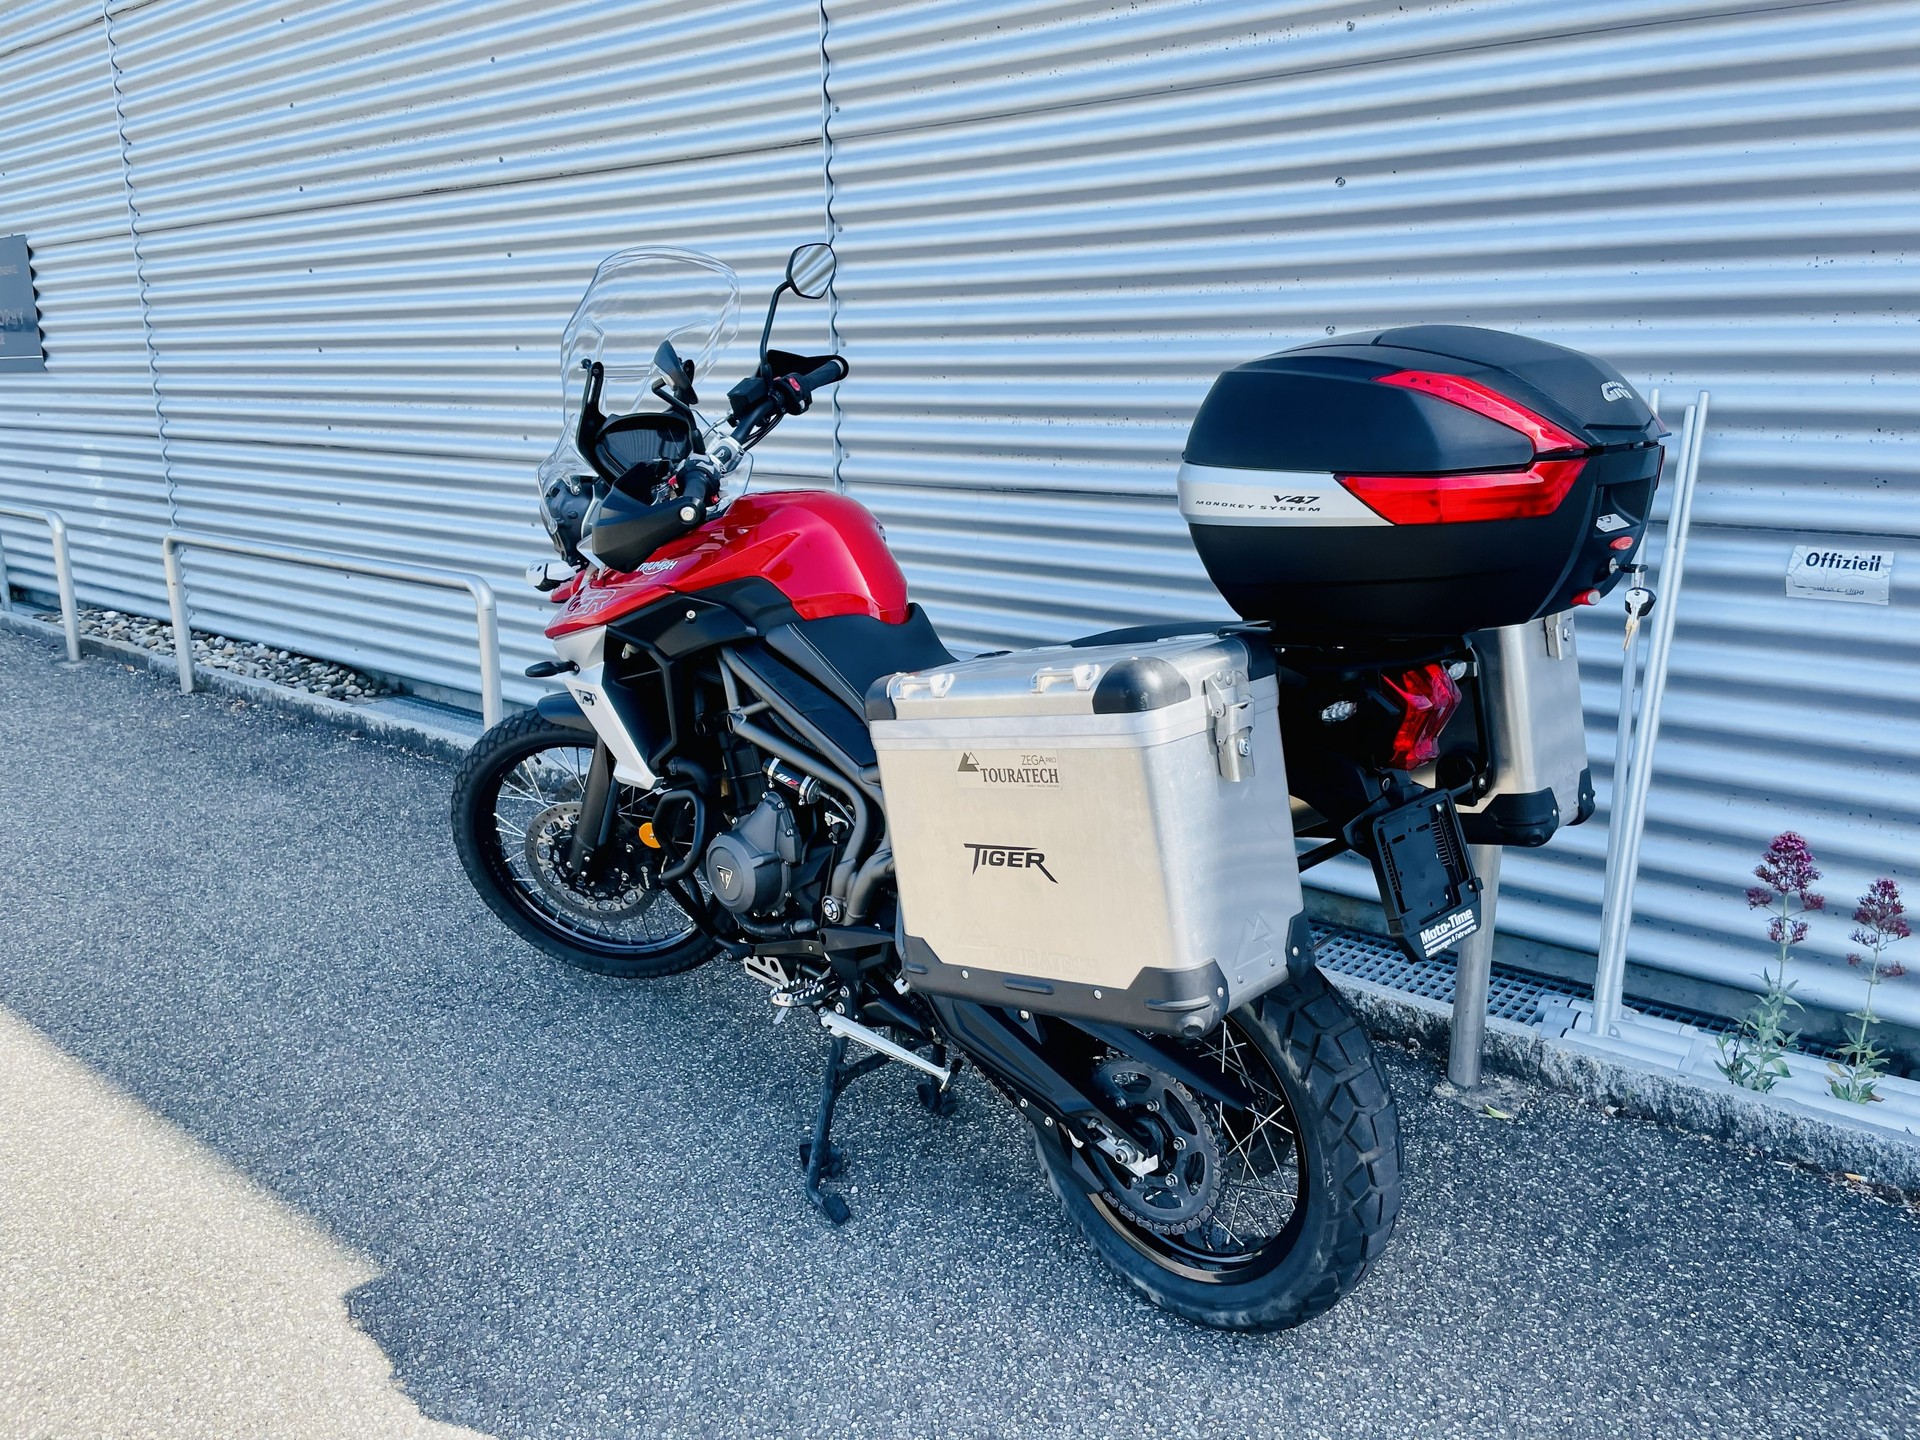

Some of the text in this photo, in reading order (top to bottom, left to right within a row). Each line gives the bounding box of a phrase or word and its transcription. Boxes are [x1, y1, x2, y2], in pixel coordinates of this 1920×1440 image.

[1195, 500, 1255, 509] MONOKEY
[1273, 495, 1320, 504] V47
[1020, 754, 1057, 766] ZEGA PRO
[980, 767, 1060, 784] TOURATECH
[963, 842, 1059, 884] TIGER
[1419, 908, 1474, 945] Moto-Time
